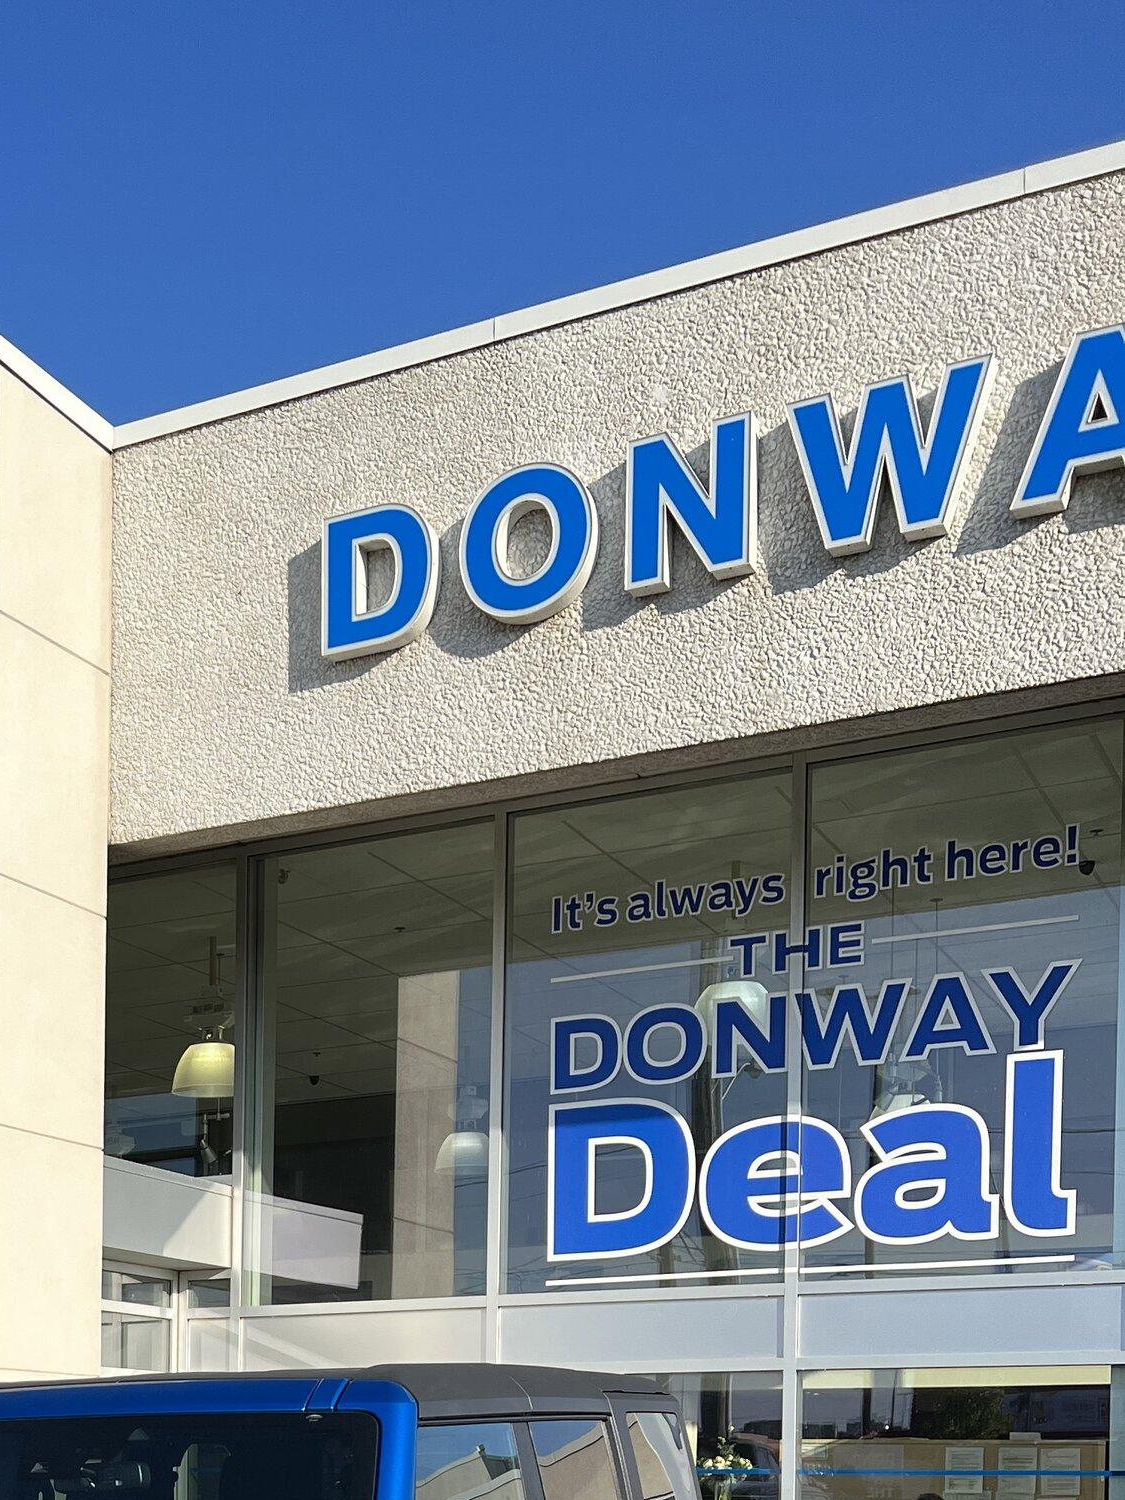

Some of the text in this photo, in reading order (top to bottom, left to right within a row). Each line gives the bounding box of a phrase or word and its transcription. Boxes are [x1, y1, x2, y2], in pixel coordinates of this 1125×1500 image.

[321, 323, 1125, 662] DONWA
[551, 823, 1081, 934] It's always right here!
[728, 921, 867, 978] THE
[550, 958, 1083, 1095] DONWAY
[547, 1049, 1078, 1262] Deal
